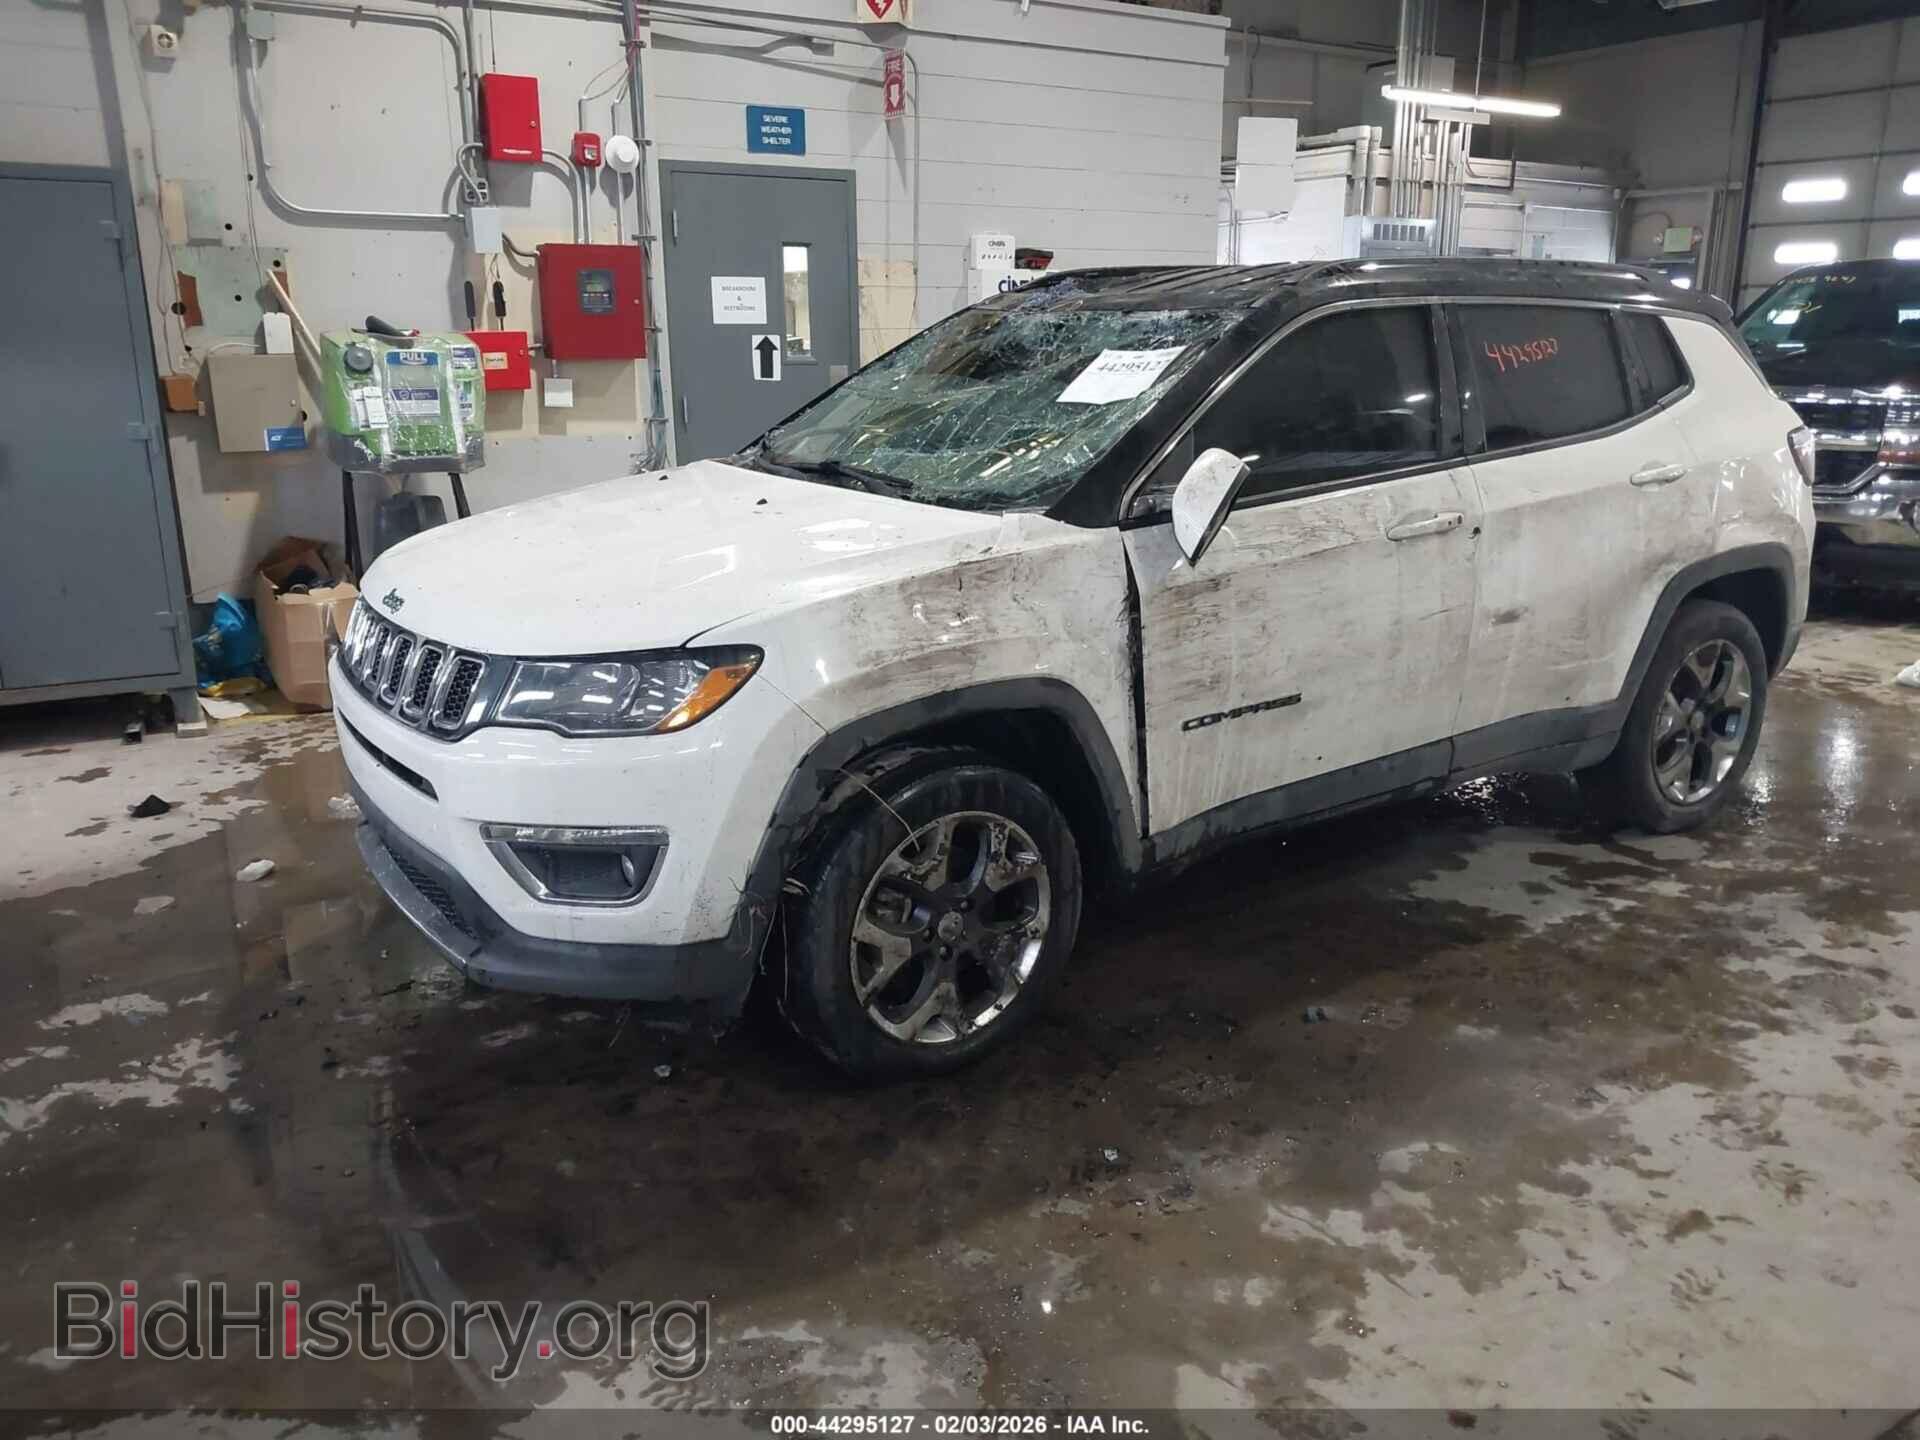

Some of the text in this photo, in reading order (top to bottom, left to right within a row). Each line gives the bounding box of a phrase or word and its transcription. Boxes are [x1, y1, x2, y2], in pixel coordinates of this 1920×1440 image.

[762, 114, 788, 123] SEVERE
[761, 126, 792, 135] WEATHER
[762, 137, 791, 145] SHELTER
[400, 351, 427, 361] PULL
[1181, 693, 1302, 732] COMPASS
